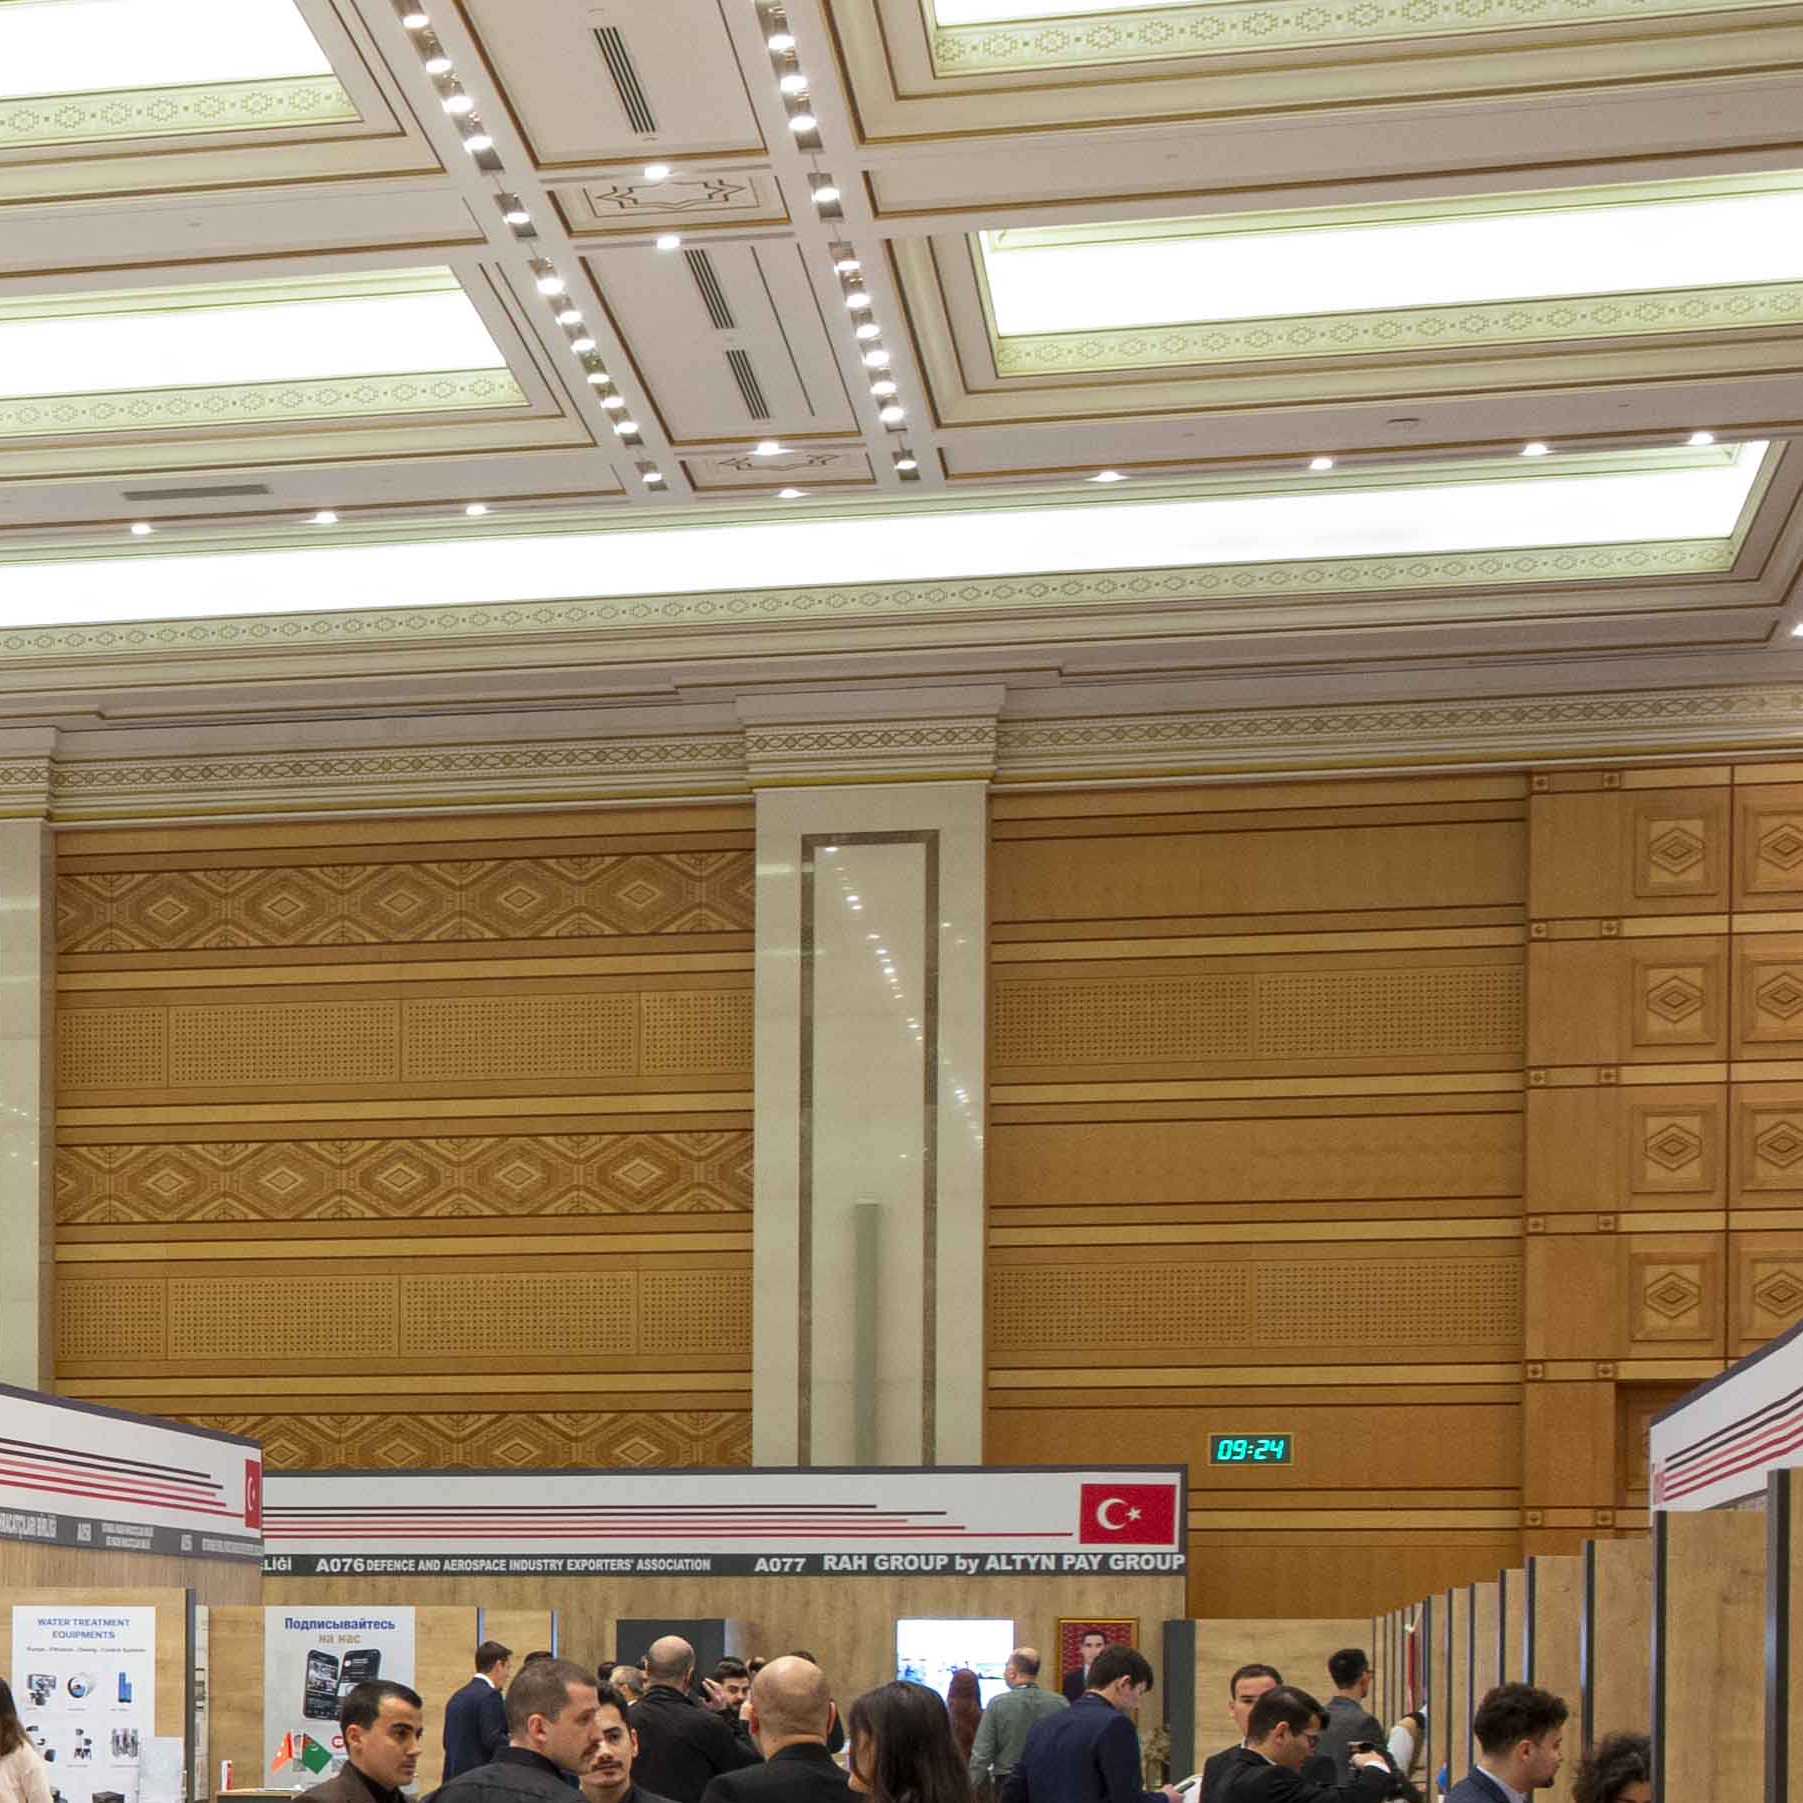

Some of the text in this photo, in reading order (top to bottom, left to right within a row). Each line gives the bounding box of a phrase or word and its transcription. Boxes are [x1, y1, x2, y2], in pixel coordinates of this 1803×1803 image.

[1217, 1439, 1284, 1460] 09:24
[315, 1558, 365, 1573] A076
[366, 1559, 415, 1572] DEFENCE
[417, 1559, 441, 1572] AND
[443, 1559, 507, 1572] AEROSPACE
[509, 1559, 564, 1572] INDUSTRY
[636, 1558, 711, 1572] ASSOCIATION
[754, 1557, 806, 1573] A077
[823, 1554, 1186, 1574] RAH GROUP by ALTYN PAY GROUP
[37, 1618, 131, 1628] WATER TREATMENT
[284, 1617, 396, 1631] Подписывайтесь
[52, 1630, 116, 1640] EQUIPMENTS
[318, 1635, 361, 1645] на нас
